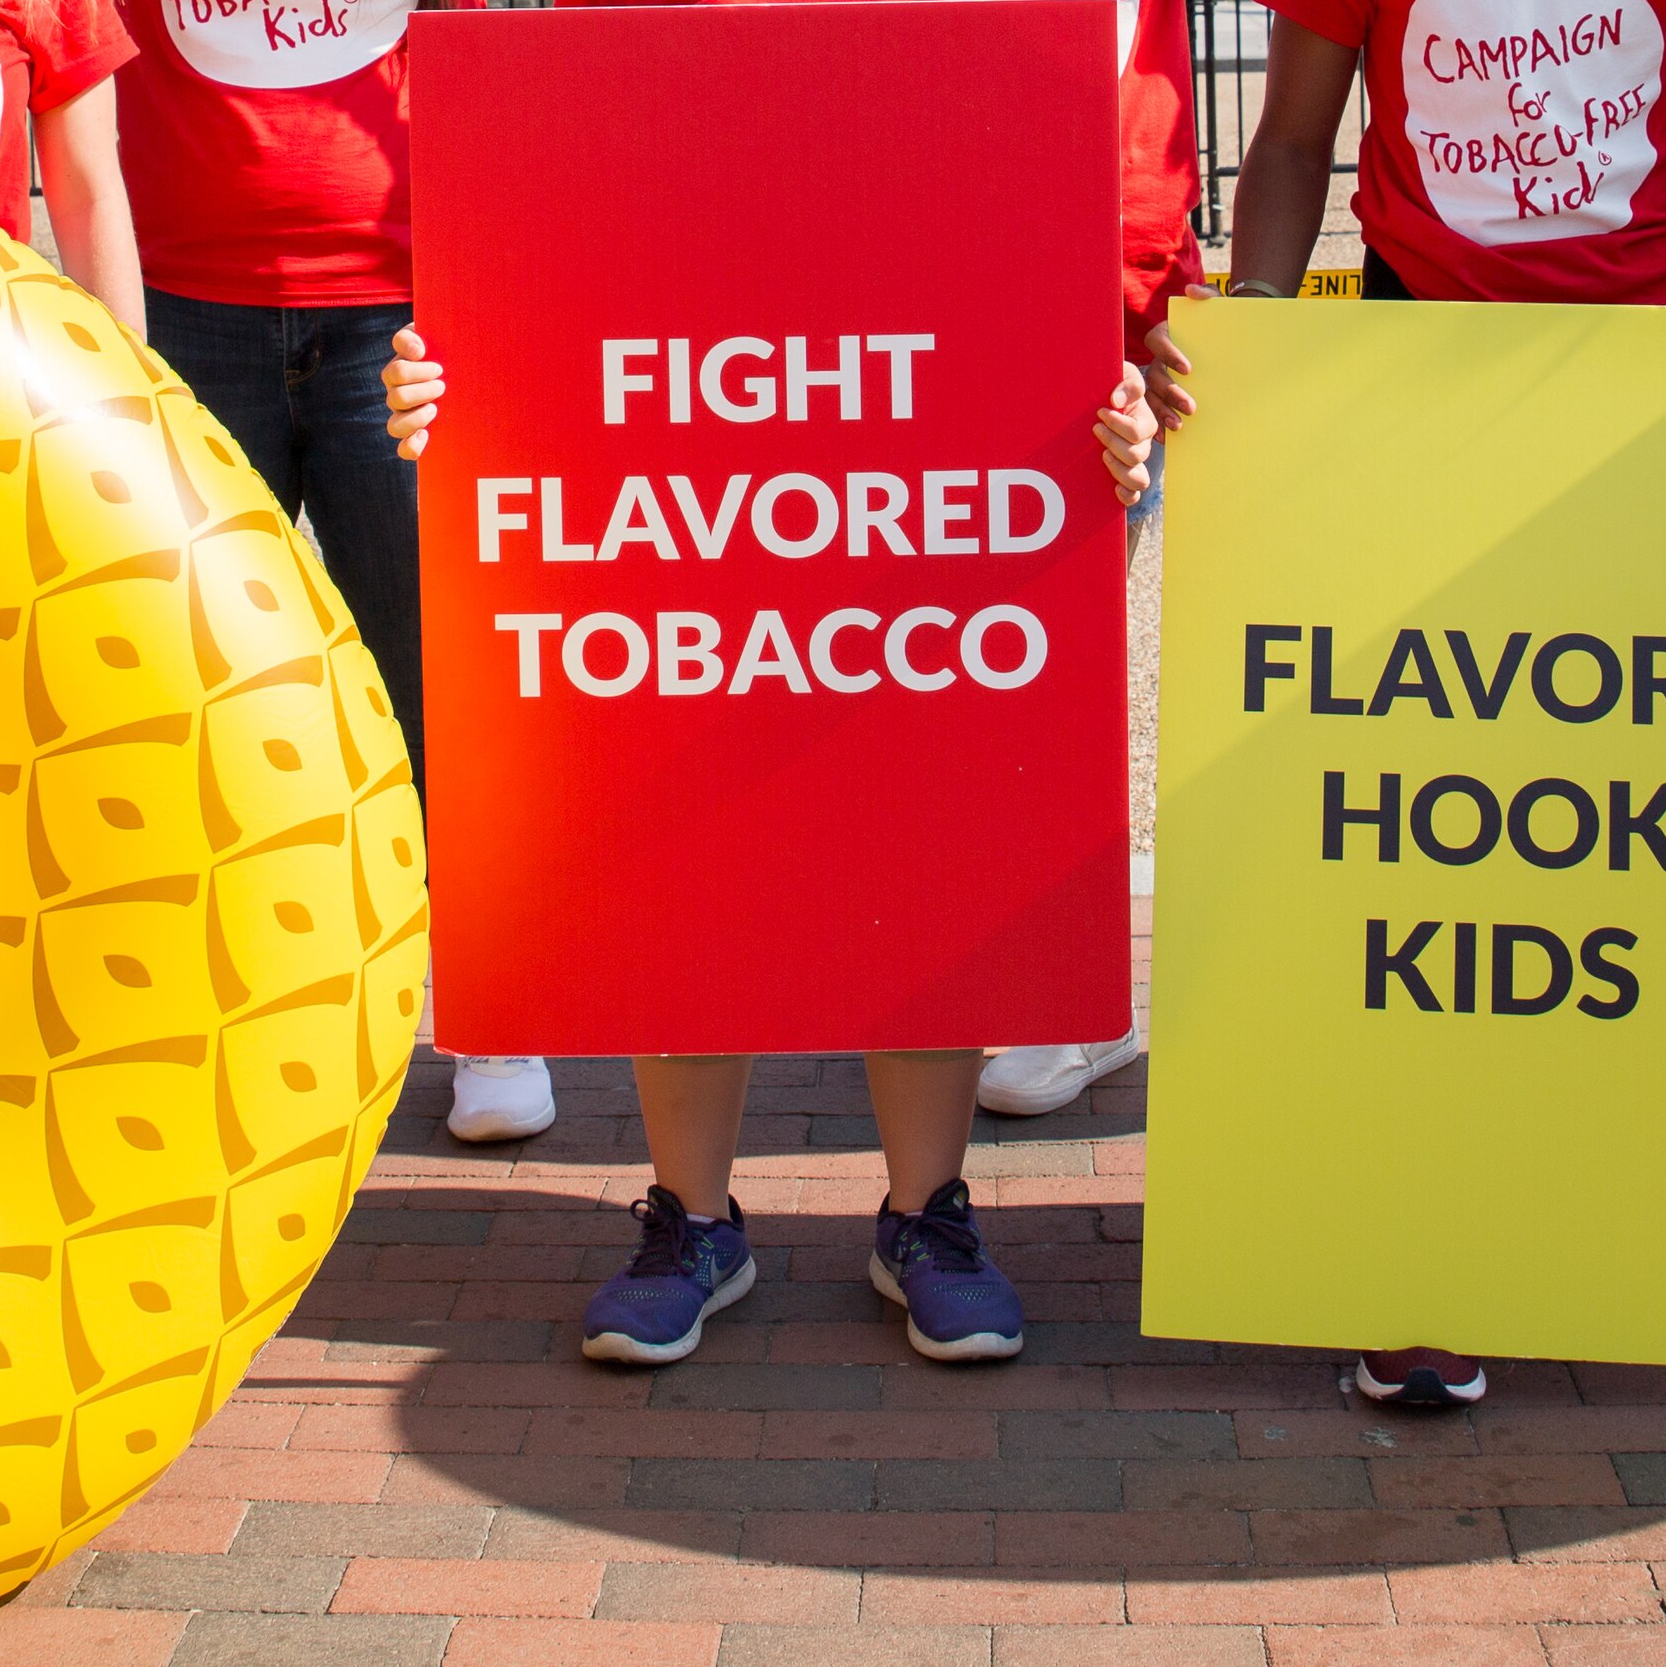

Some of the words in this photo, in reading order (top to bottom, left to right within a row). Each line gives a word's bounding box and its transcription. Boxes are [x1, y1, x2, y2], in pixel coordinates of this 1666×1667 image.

[1423, 8, 1623, 83] CAMPAIGN
[1420, 83, 1646, 174] TOBACCO-FREE
[603, 334, 935, 424] FIGHT
[477, 469, 1065, 562] FLAVORED
[495, 605, 1047, 697] TOBACCO
[1365, 919, 1639, 1019] KIDS
